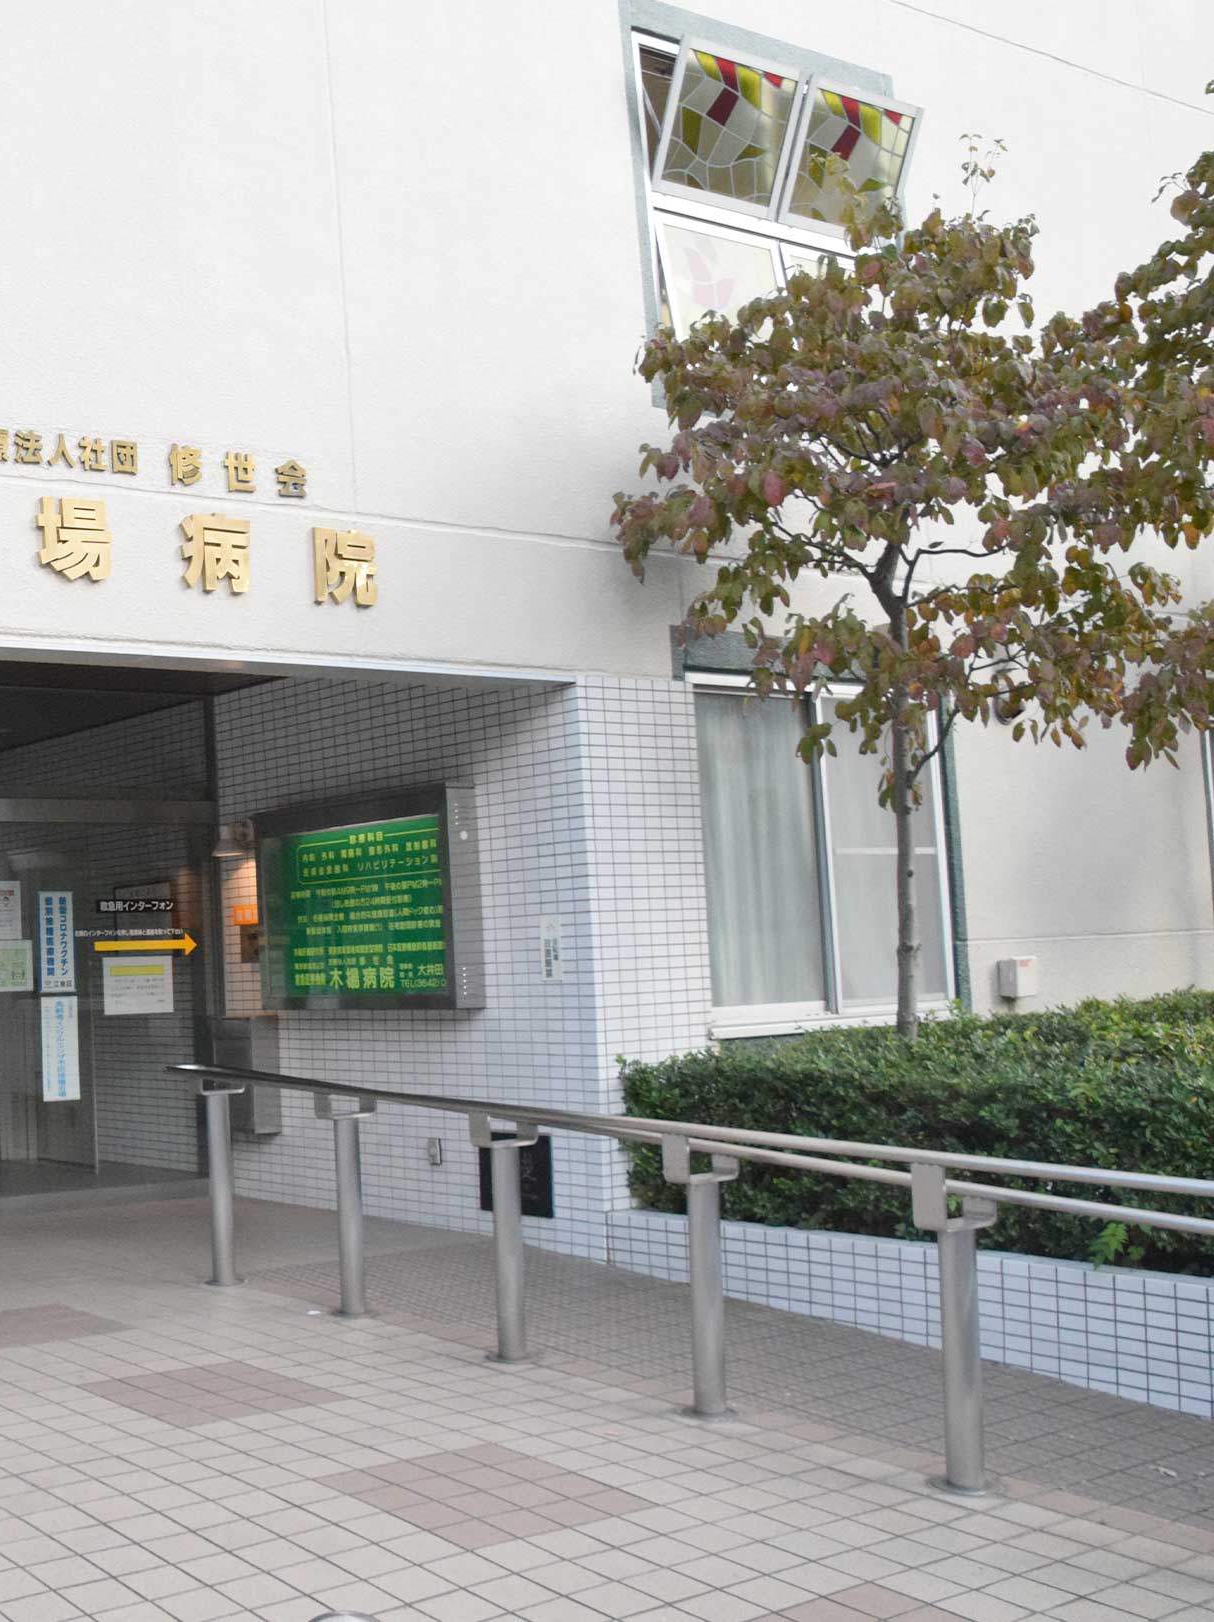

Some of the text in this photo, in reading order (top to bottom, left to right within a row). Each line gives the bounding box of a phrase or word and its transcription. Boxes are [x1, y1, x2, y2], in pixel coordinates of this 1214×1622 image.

[168, 443, 306, 498] 修世会
[99, 901, 174, 912] 救急用インターフォン
